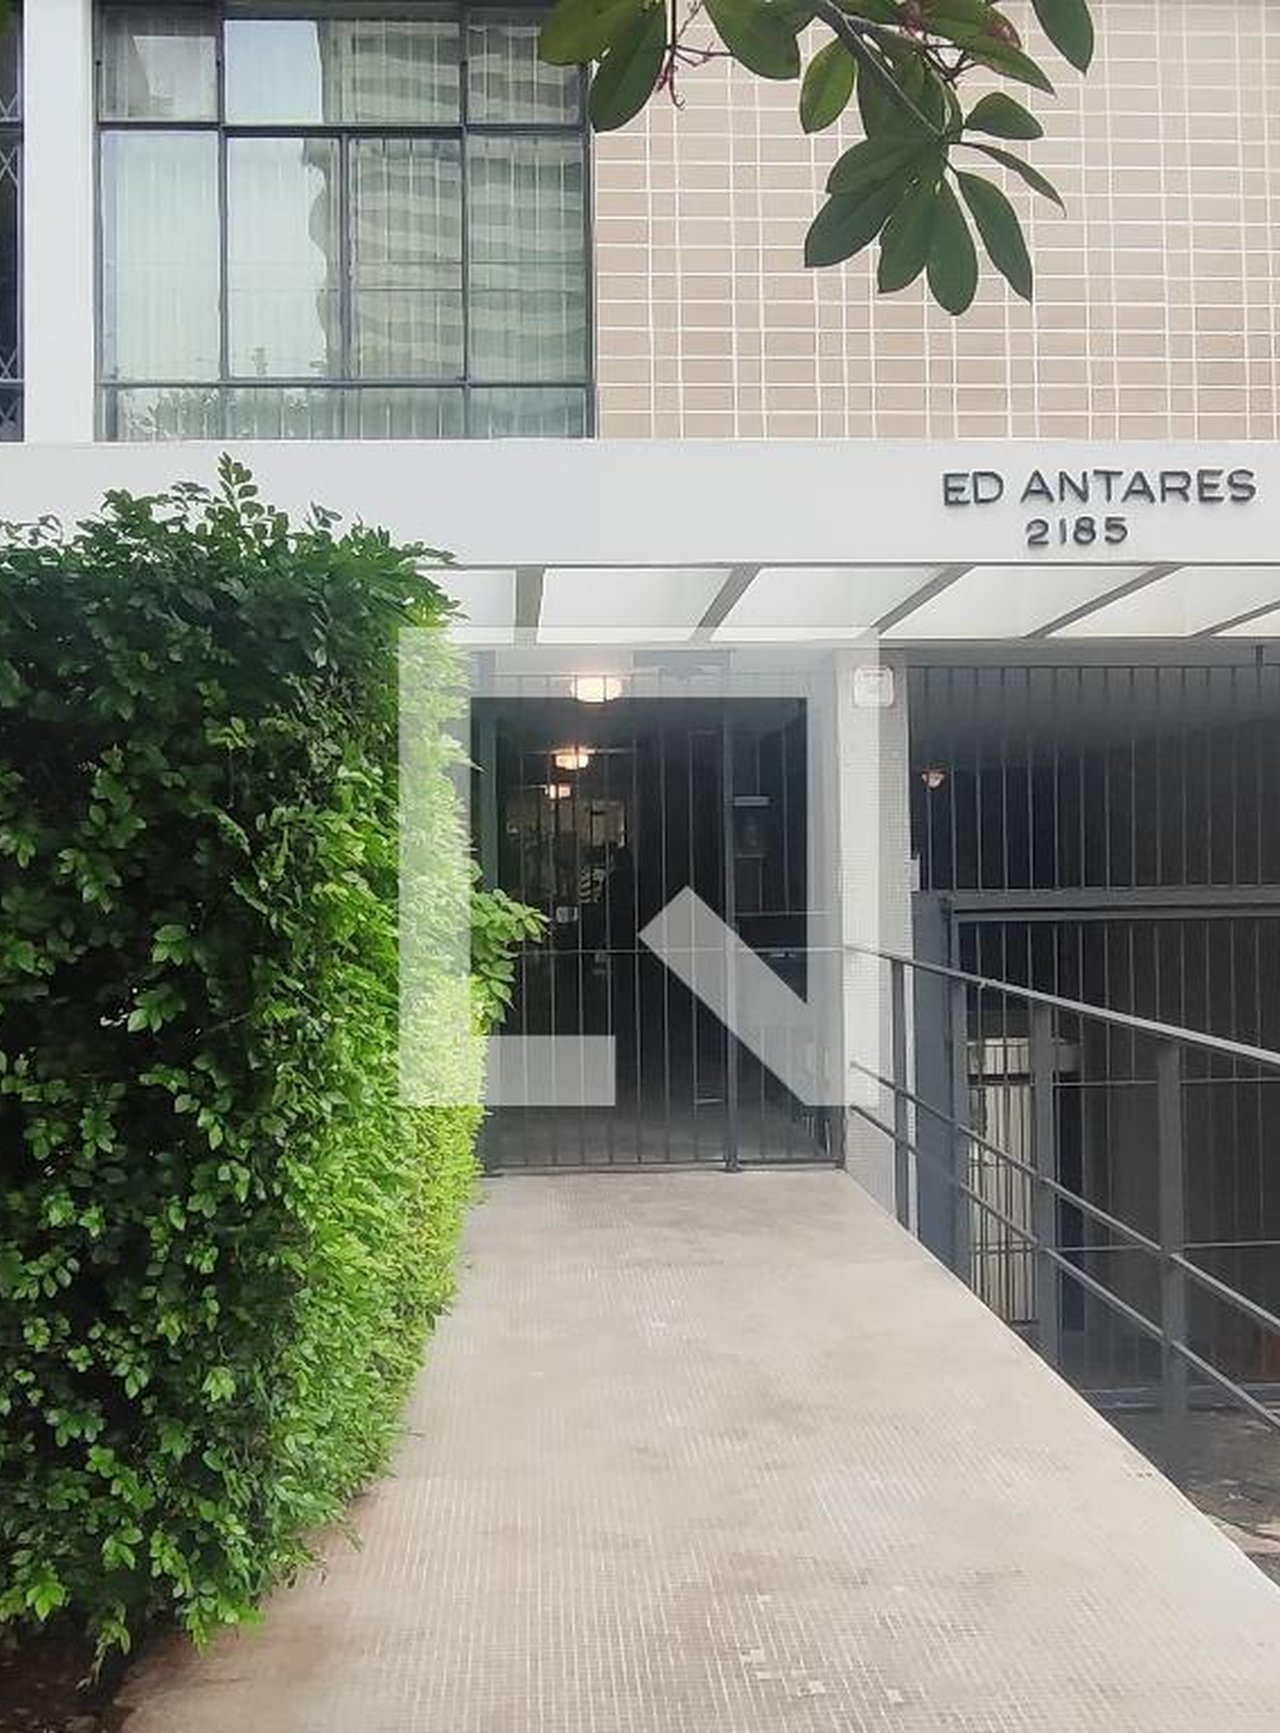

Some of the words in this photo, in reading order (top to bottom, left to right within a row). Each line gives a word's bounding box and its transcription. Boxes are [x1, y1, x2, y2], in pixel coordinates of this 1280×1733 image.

[942, 471, 1004, 507] ED
[1020, 469, 1257, 504] ANTARES
[1025, 515, 1129, 547] 2185
